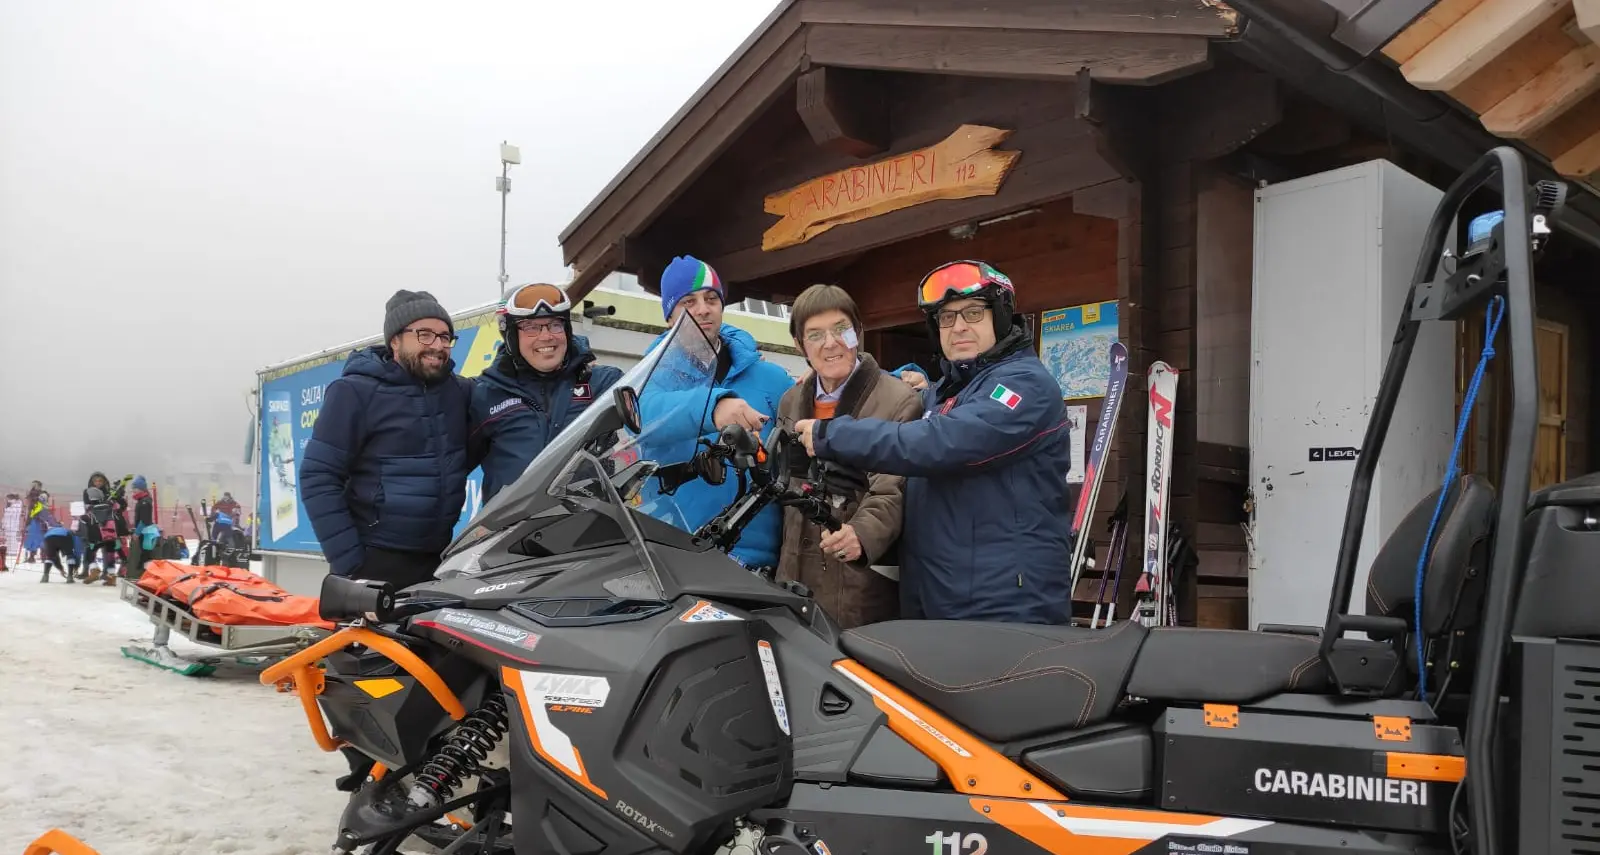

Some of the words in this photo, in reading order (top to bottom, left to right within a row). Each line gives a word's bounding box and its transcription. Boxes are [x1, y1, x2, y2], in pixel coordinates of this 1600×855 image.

[787, 151, 936, 221] CARABINIERI
[956, 163, 976, 183] 112
[1044, 322, 1075, 333] SKIAREA
[301, 385, 321, 406] SALTA
[1095, 380, 1120, 452] CARABINIERI
[1150, 419, 1164, 494] NORDICA
[474, 583, 507, 595] 600
[534, 674, 602, 695] LYNX
[549, 703, 596, 714] ALPINE
[1254, 767, 1428, 807] CARABINIERI
[615, 799, 658, 833] ROTAX
[925, 830, 988, 855] 112
